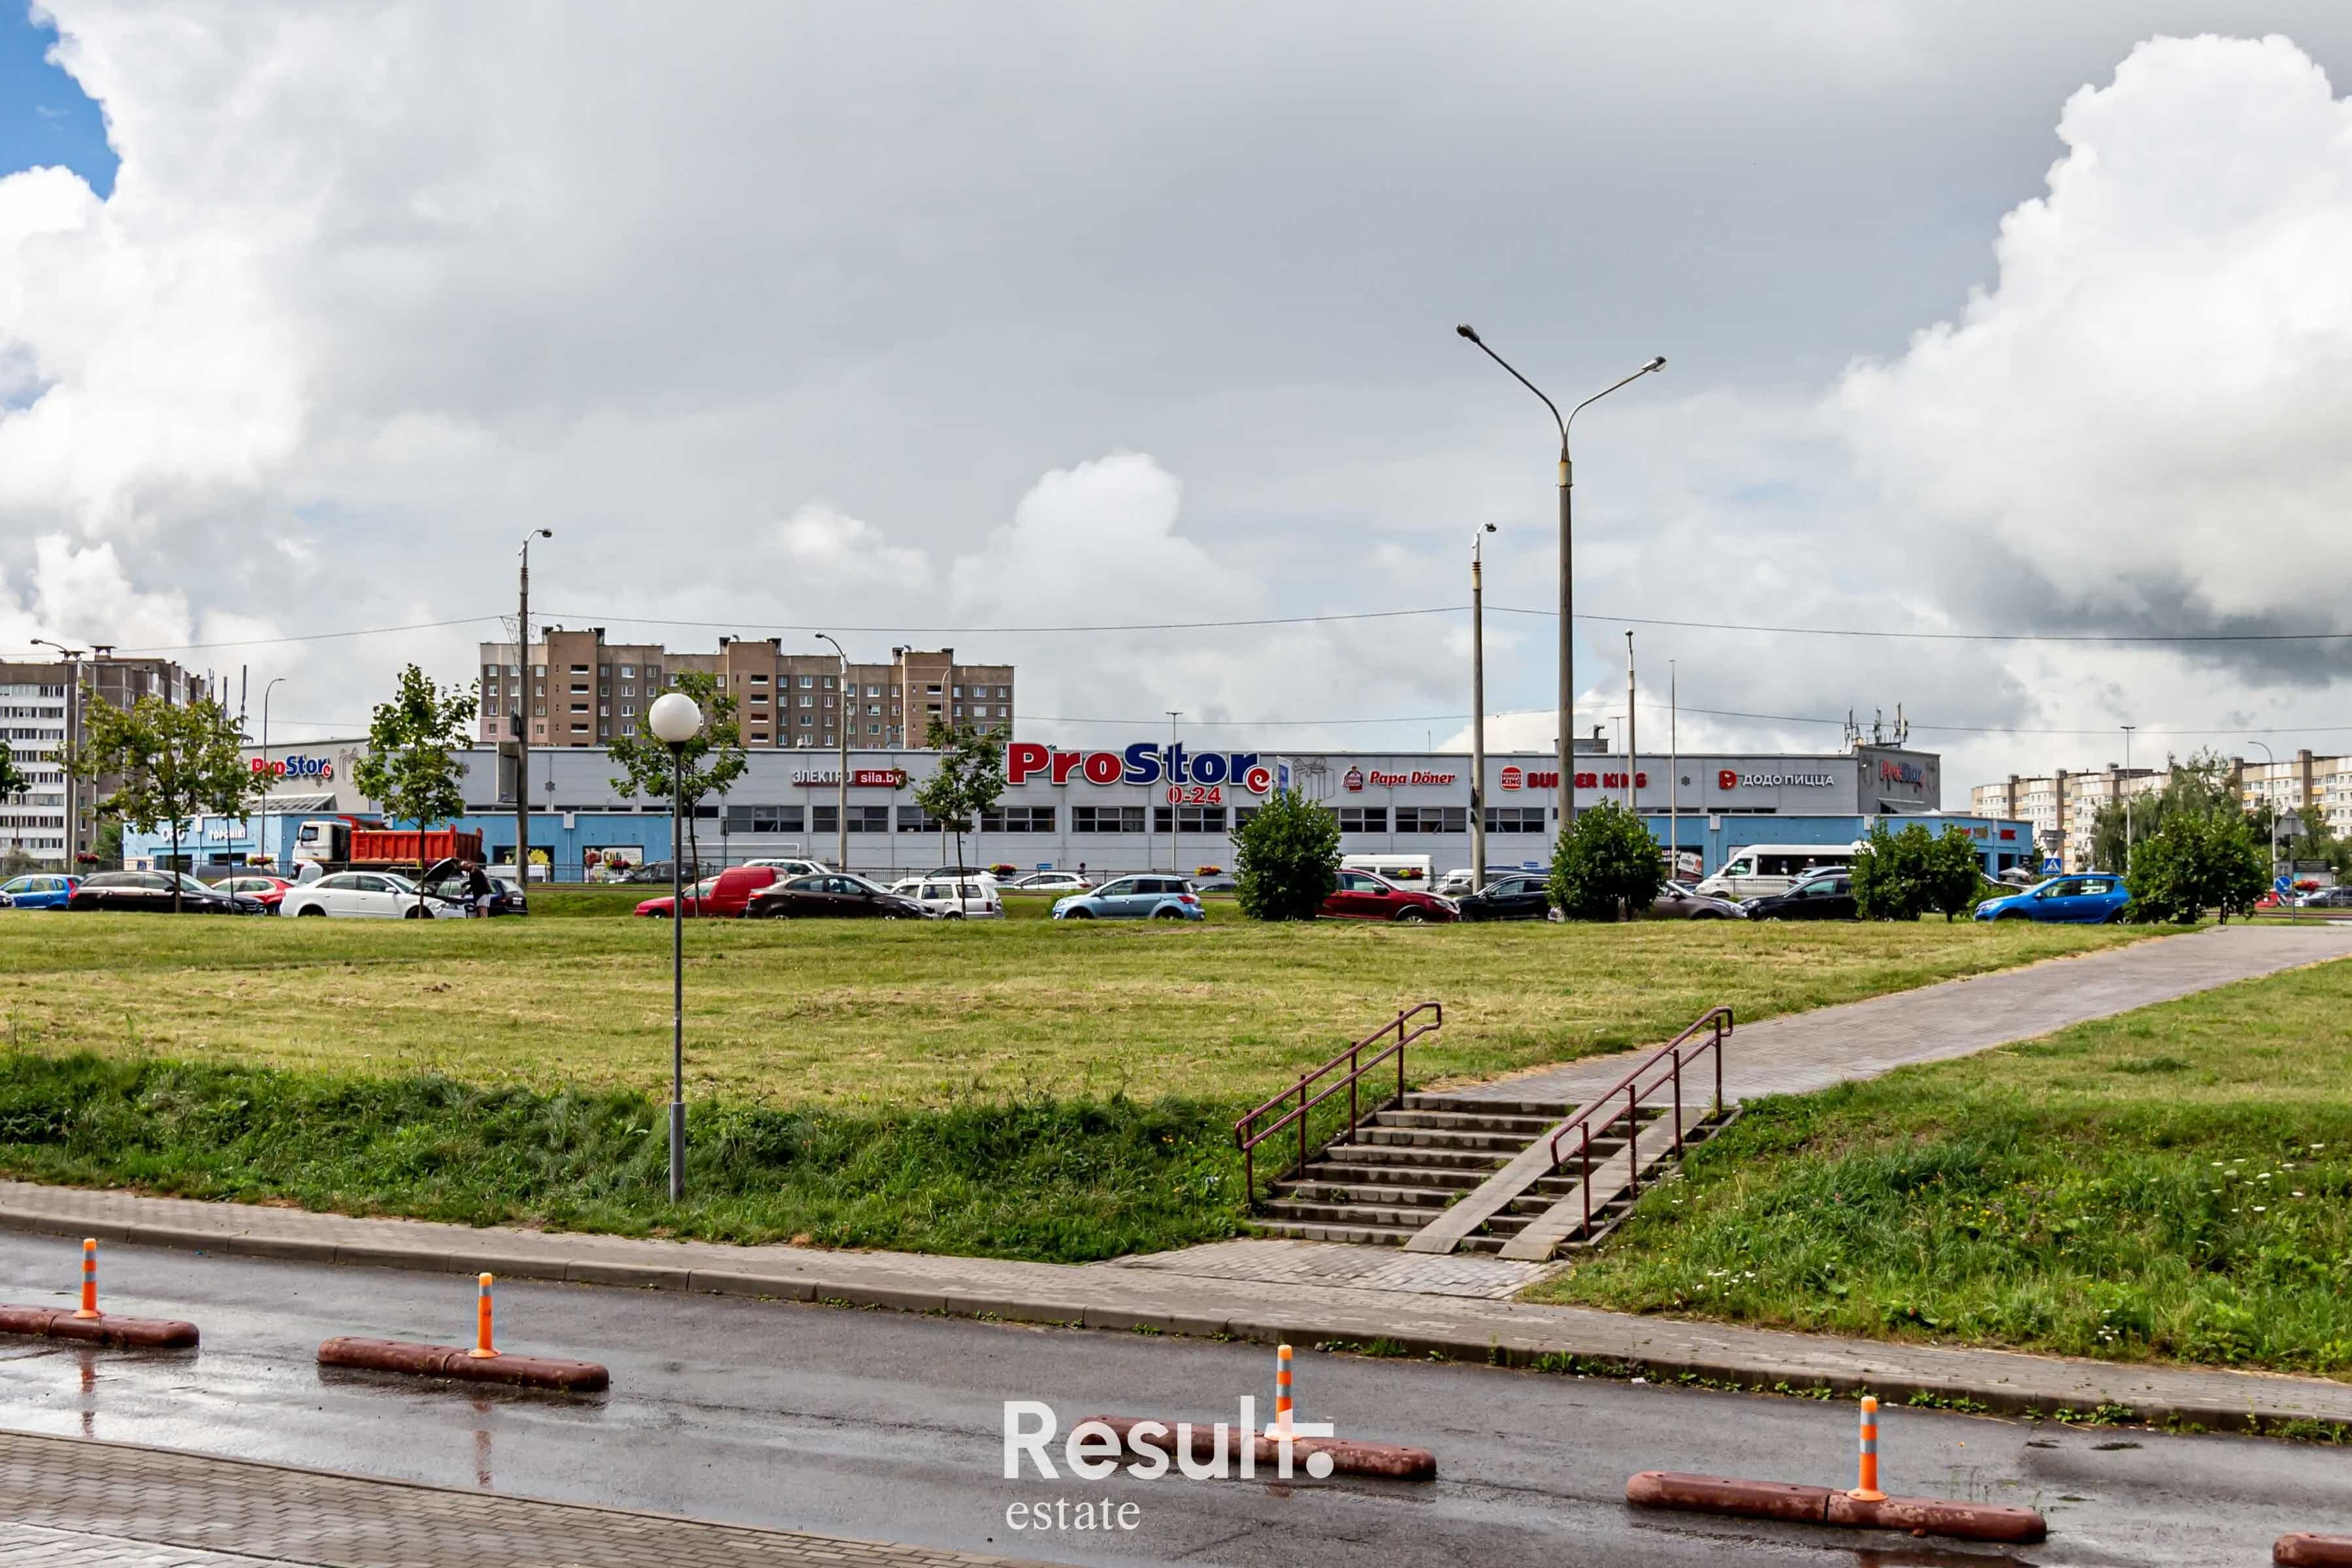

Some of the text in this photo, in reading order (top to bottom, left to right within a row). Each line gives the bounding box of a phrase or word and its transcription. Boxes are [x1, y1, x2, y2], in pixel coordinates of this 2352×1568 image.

[1007, 742, 1270, 794] ProStore
[860, 772, 902, 786] sila.by
[1369, 770, 1407, 788] Papa
[1411, 770, 1456, 786] Döner
[1527, 772, 1597, 789] BUER
[1742, 774, 1835, 787] ДОДО ПИЦЦА
[1167, 785, 1222, 805] 0-24
